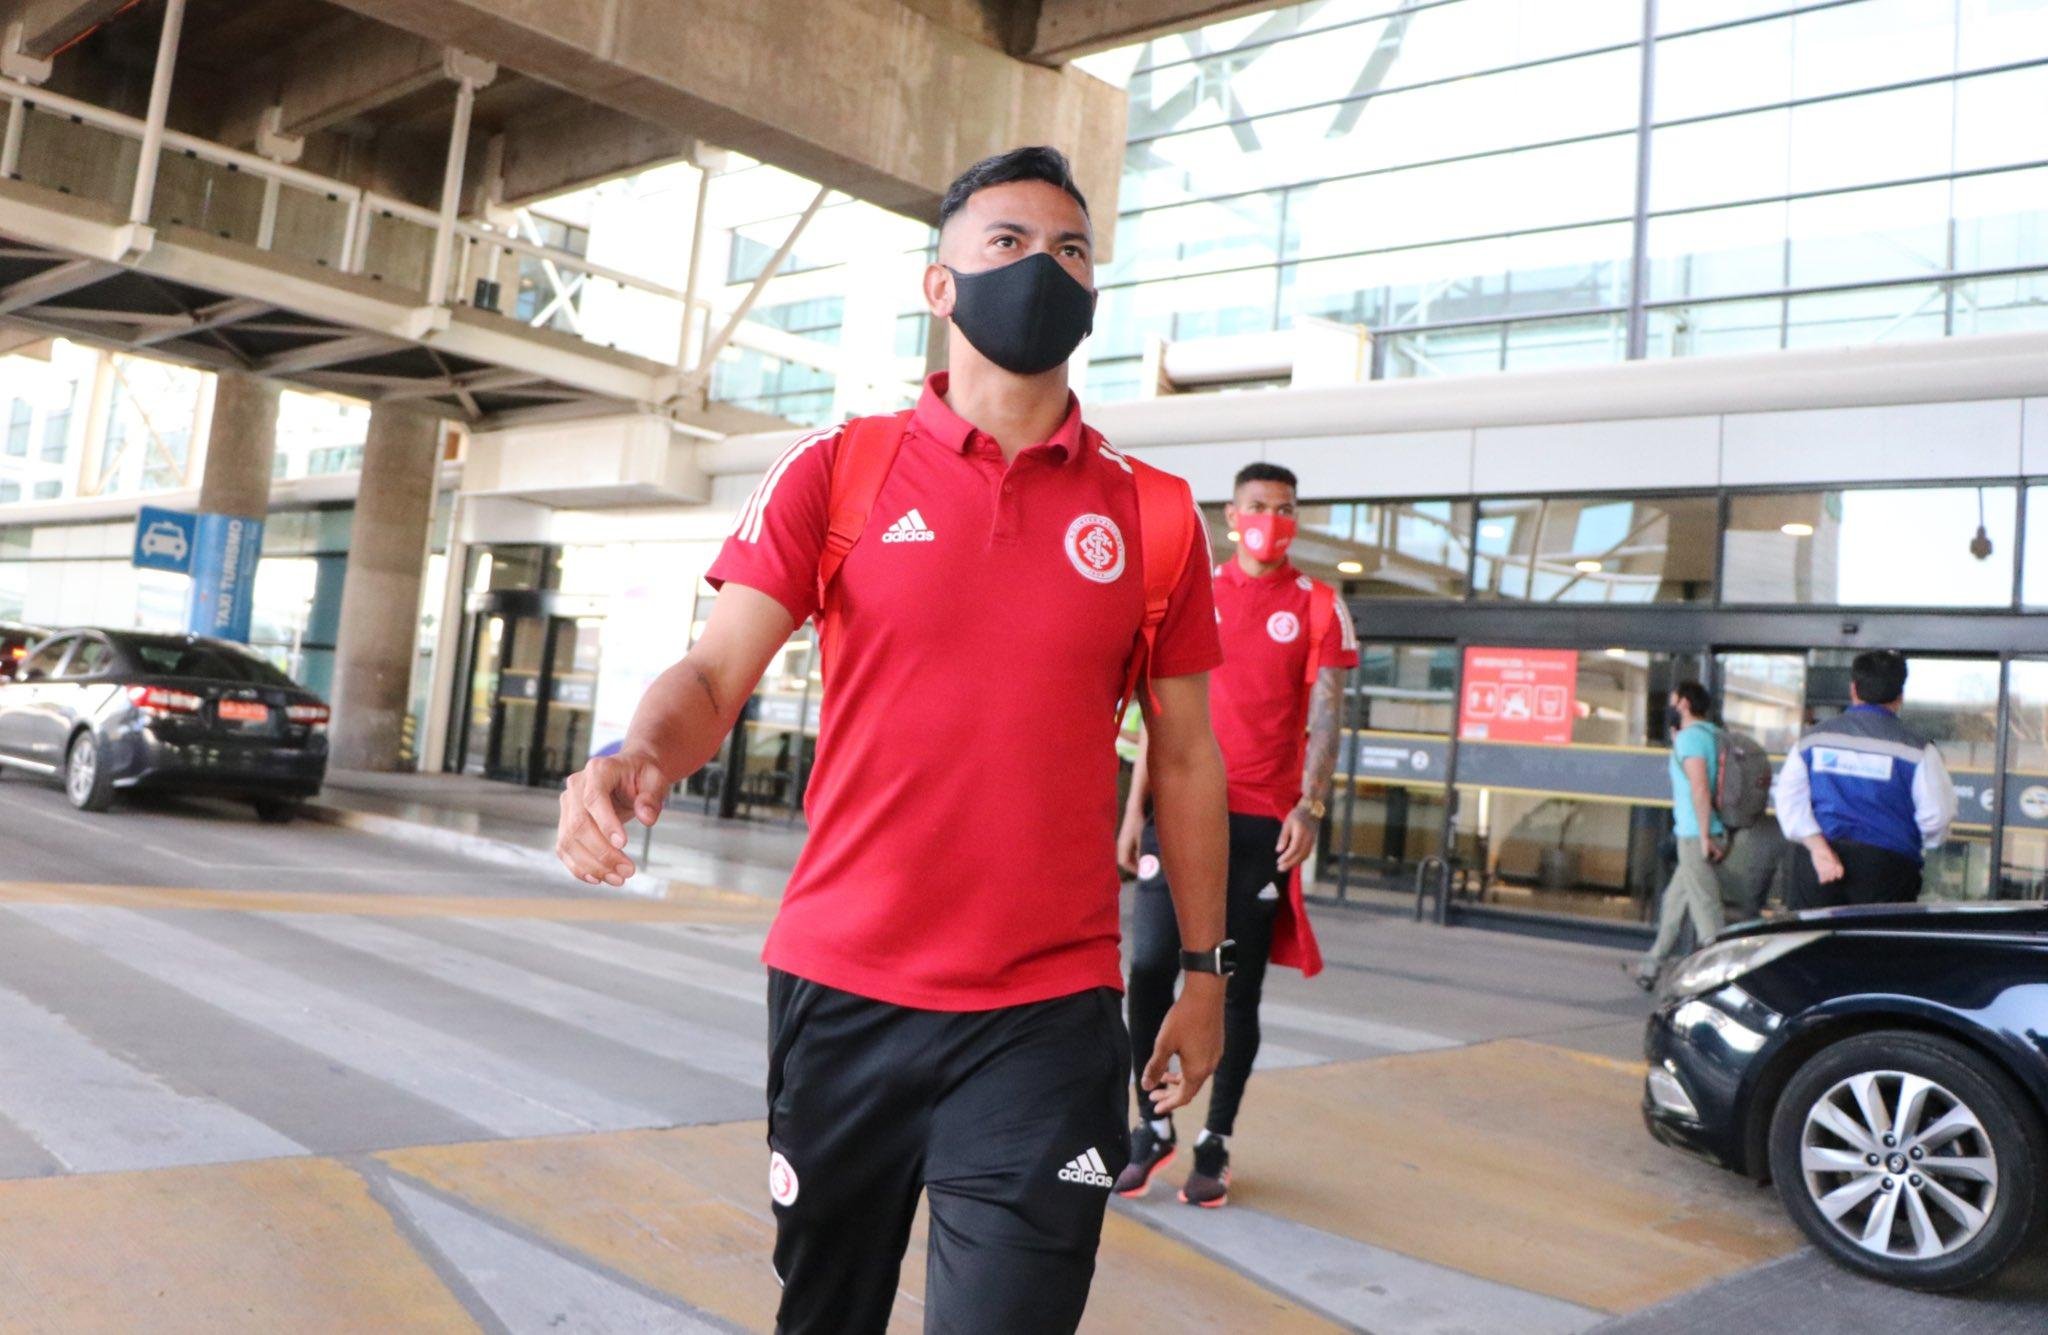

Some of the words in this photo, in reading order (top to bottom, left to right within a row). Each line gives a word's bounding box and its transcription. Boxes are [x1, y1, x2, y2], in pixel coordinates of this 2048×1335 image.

[882, 529, 935, 543] adidas
[220, 518, 243, 590] TURISMO
[214, 592, 233, 627] TAXI
[1058, 1168, 1113, 1188] adidas
